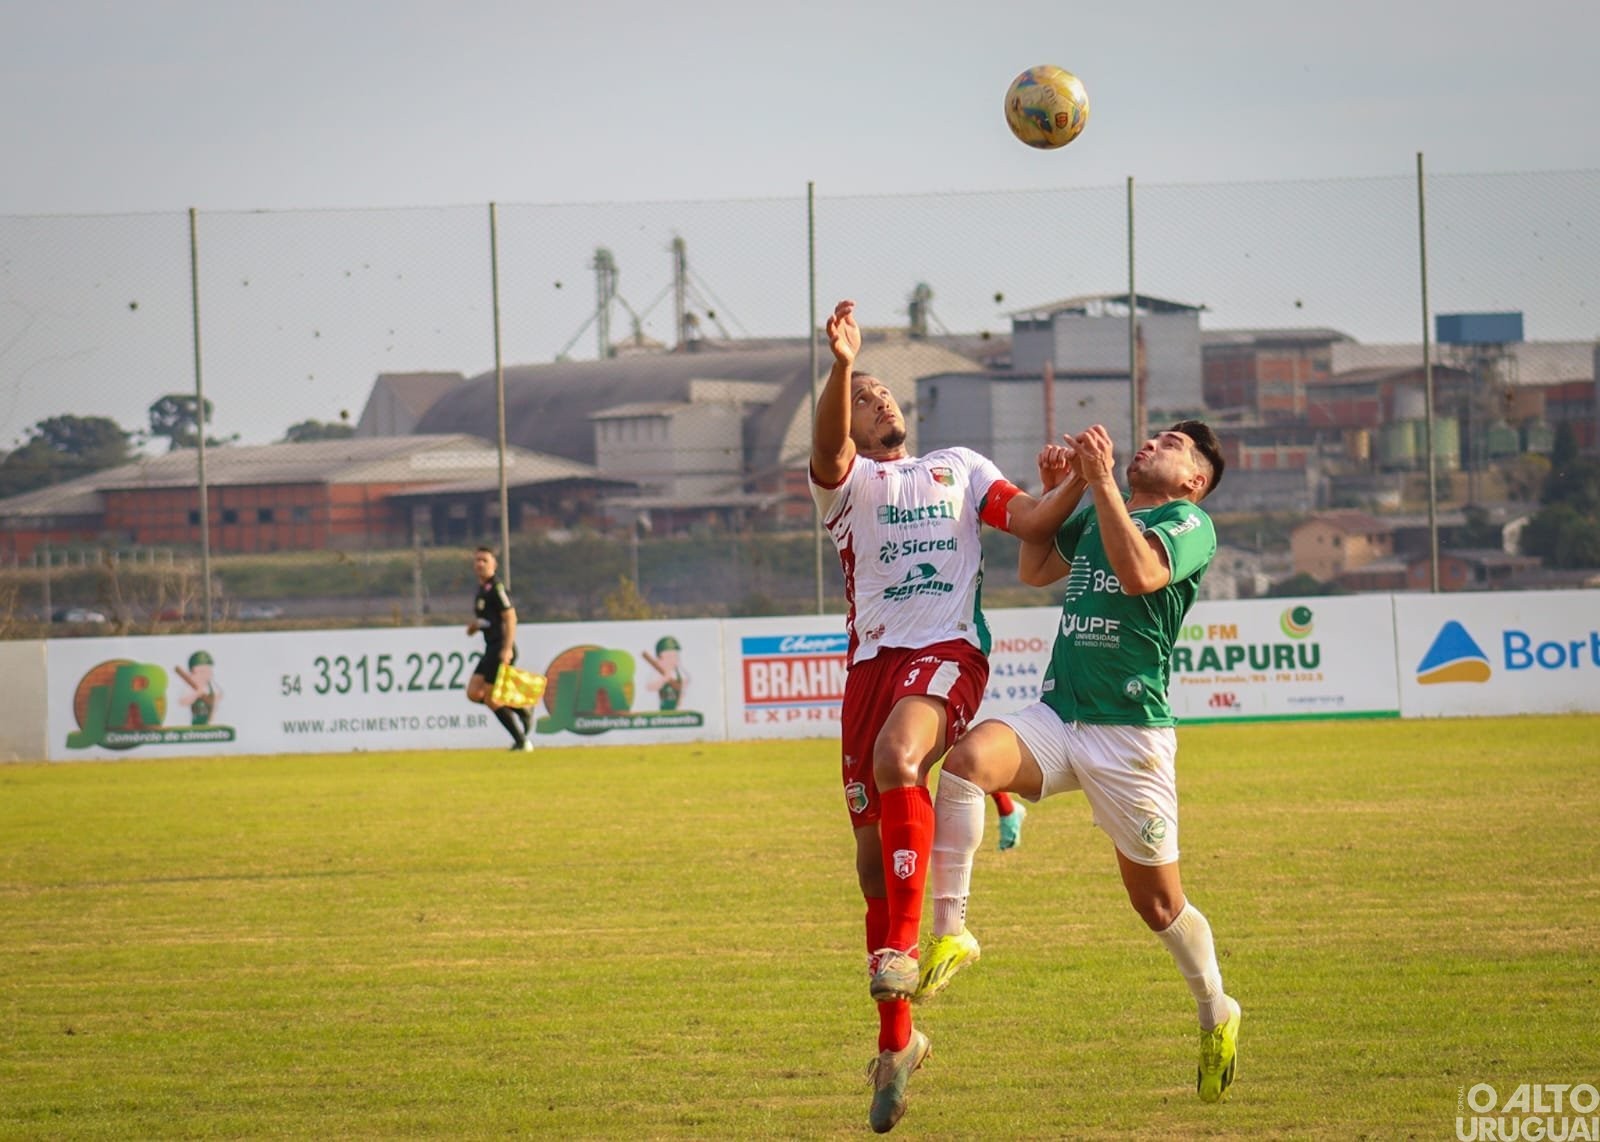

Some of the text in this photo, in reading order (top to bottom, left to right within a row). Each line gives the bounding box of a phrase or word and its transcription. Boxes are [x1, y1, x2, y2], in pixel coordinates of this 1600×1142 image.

[889, 500, 955, 524] Barril
[902, 537, 957, 556] Sicredi
[883, 580, 954, 599] Serrano
[1076, 615, 1120, 634] UPF
[1208, 624, 1238, 641] FM
[1075, 632, 1120, 642] UNIVERSIDADE
[1172, 642, 1321, 672] RAPURU
[1502, 629, 1600, 671] Bort
[994, 662, 1037, 676] 4144
[281, 675, 302, 696] 54
[283, 714, 488, 734] WWW.JRCIMENTO.COM.BR
